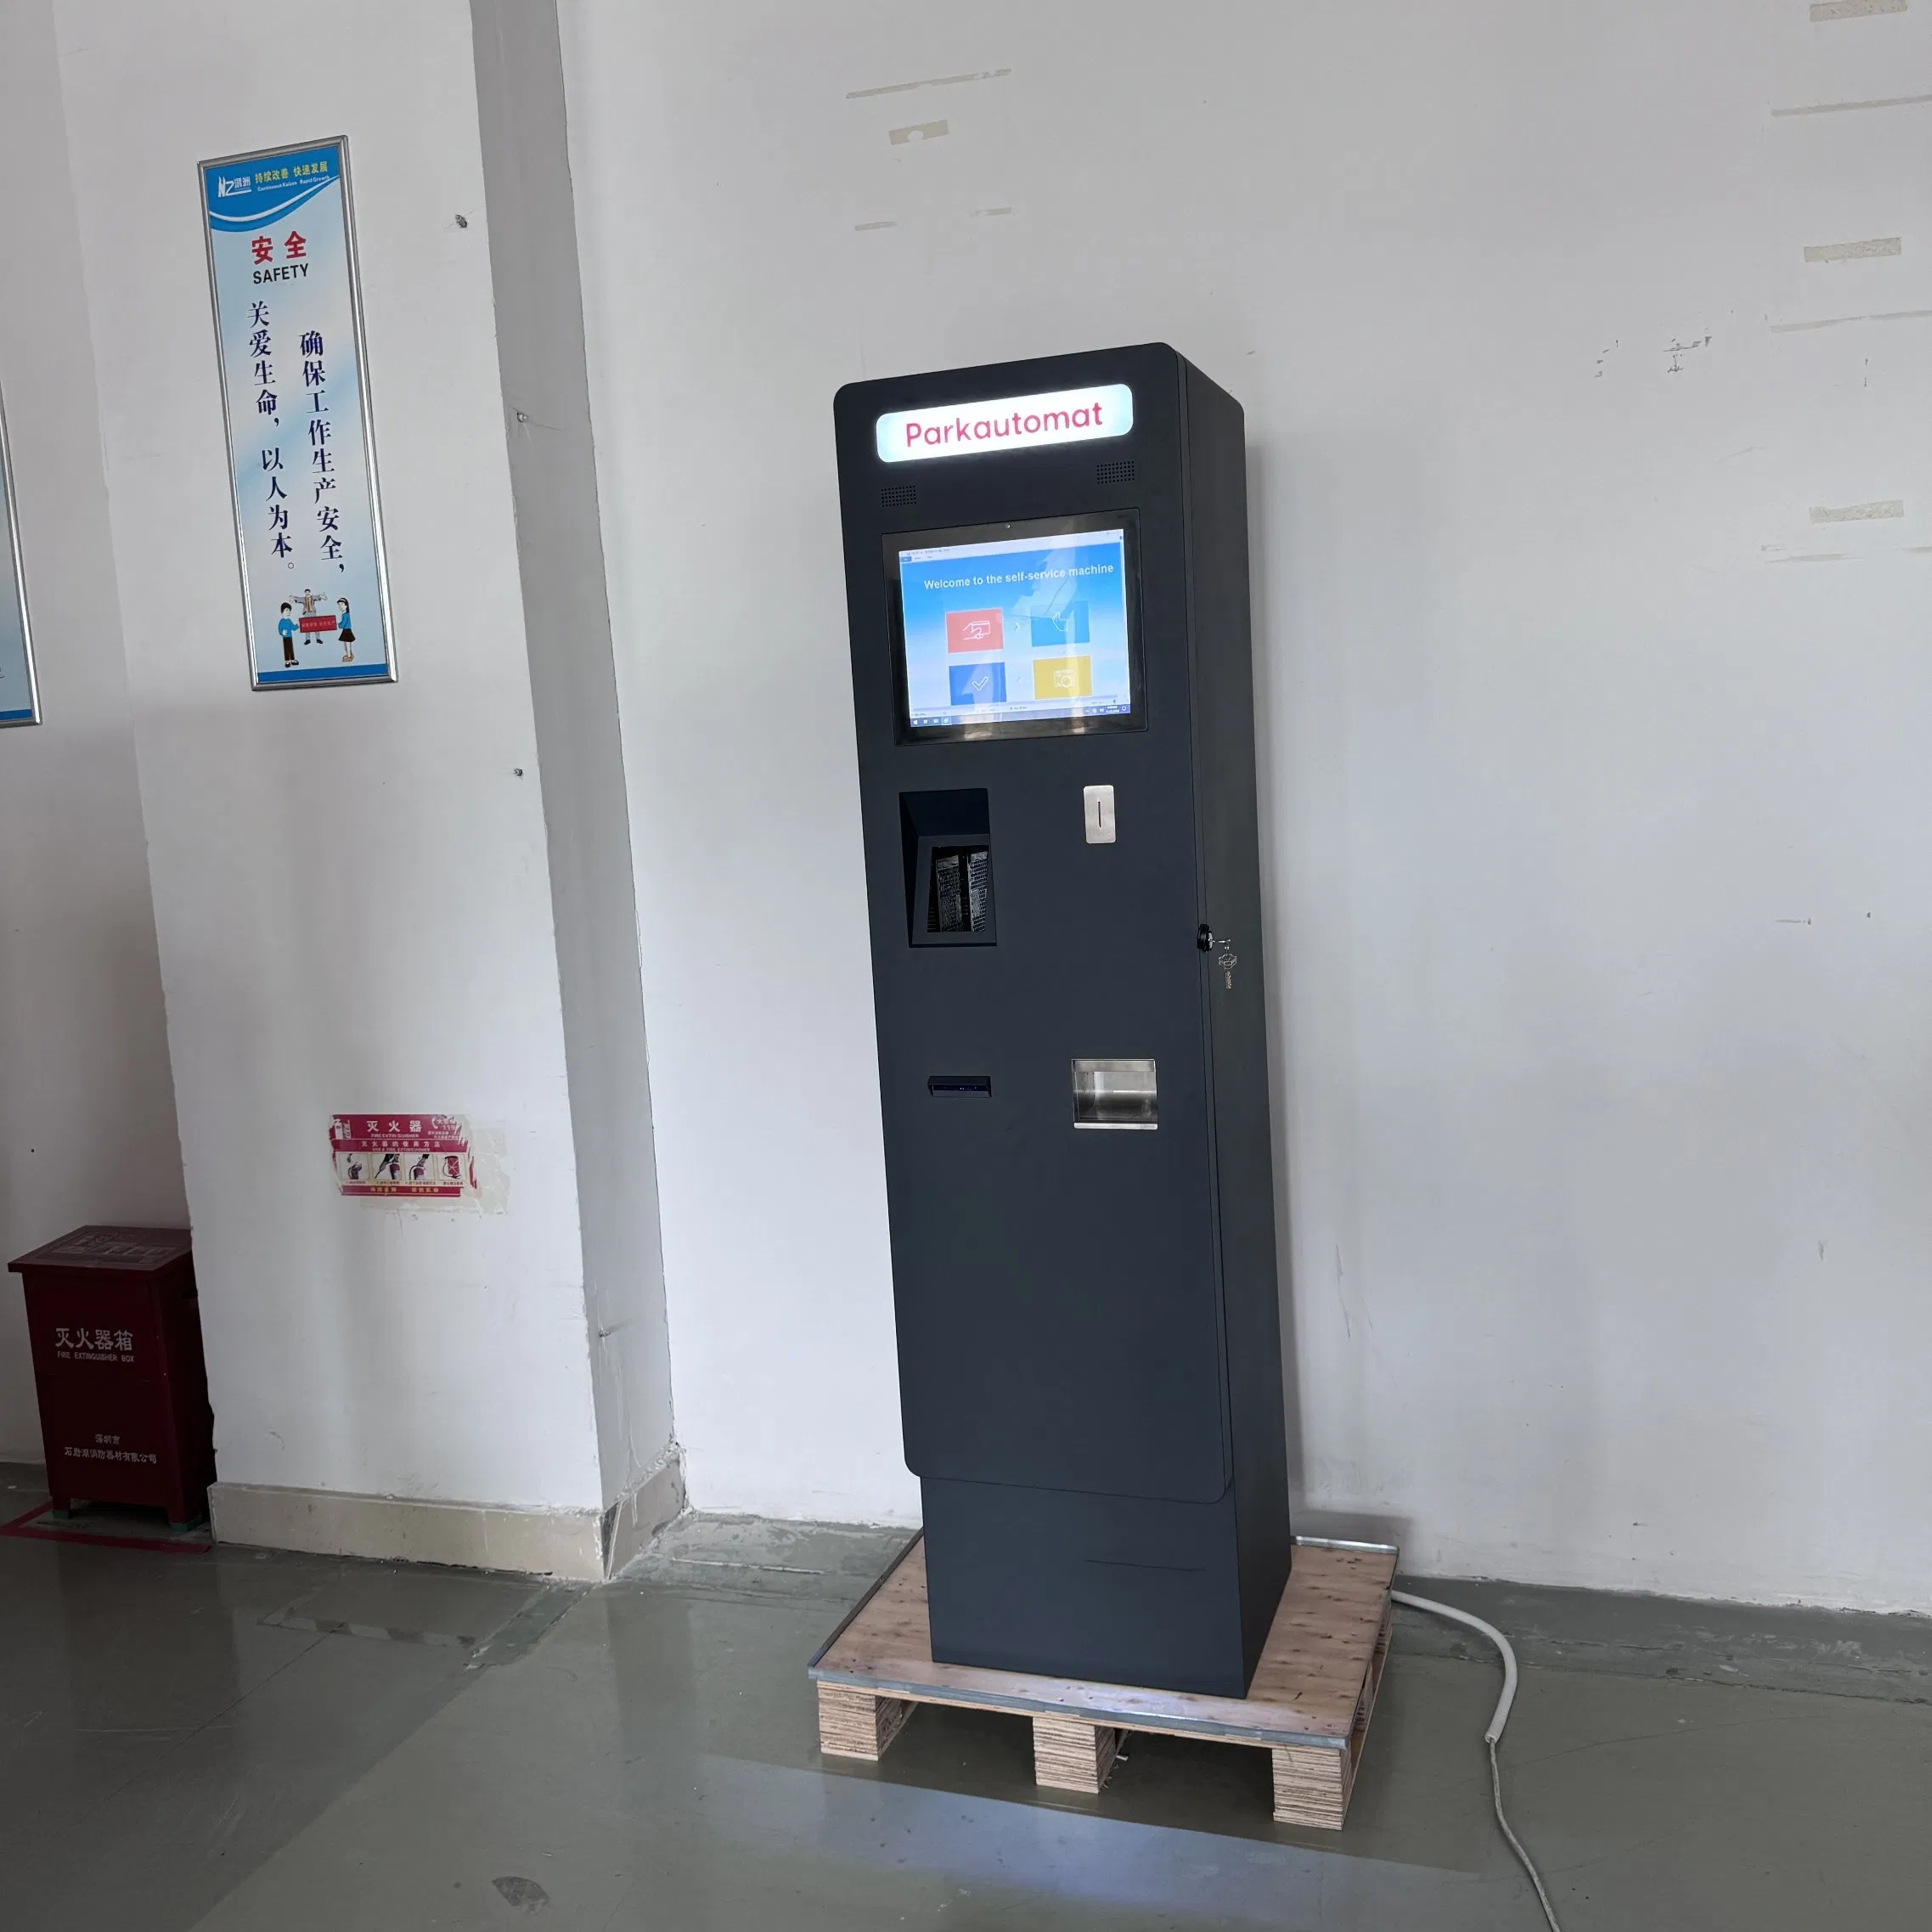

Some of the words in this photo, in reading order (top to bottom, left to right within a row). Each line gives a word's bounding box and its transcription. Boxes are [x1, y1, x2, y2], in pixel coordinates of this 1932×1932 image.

[251, 230, 307, 265] 安全
[253, 263, 309, 284] SAFETY
[905, 402, 1103, 448] Parkautomat
[923, 578, 970, 590] Welcome
[973, 577, 983, 586] to
[986, 575, 1002, 584] the
[1005, 569, 1066, 583] self-service
[1068, 564, 1114, 577] machine
[367, 1119, 423, 1133] 灭火器
[55, 1326, 133, 1351] 灭火器箱
[74, 1351, 118, 1362] EXTINGUISHER
[121, 1355, 134, 1363] BOX
